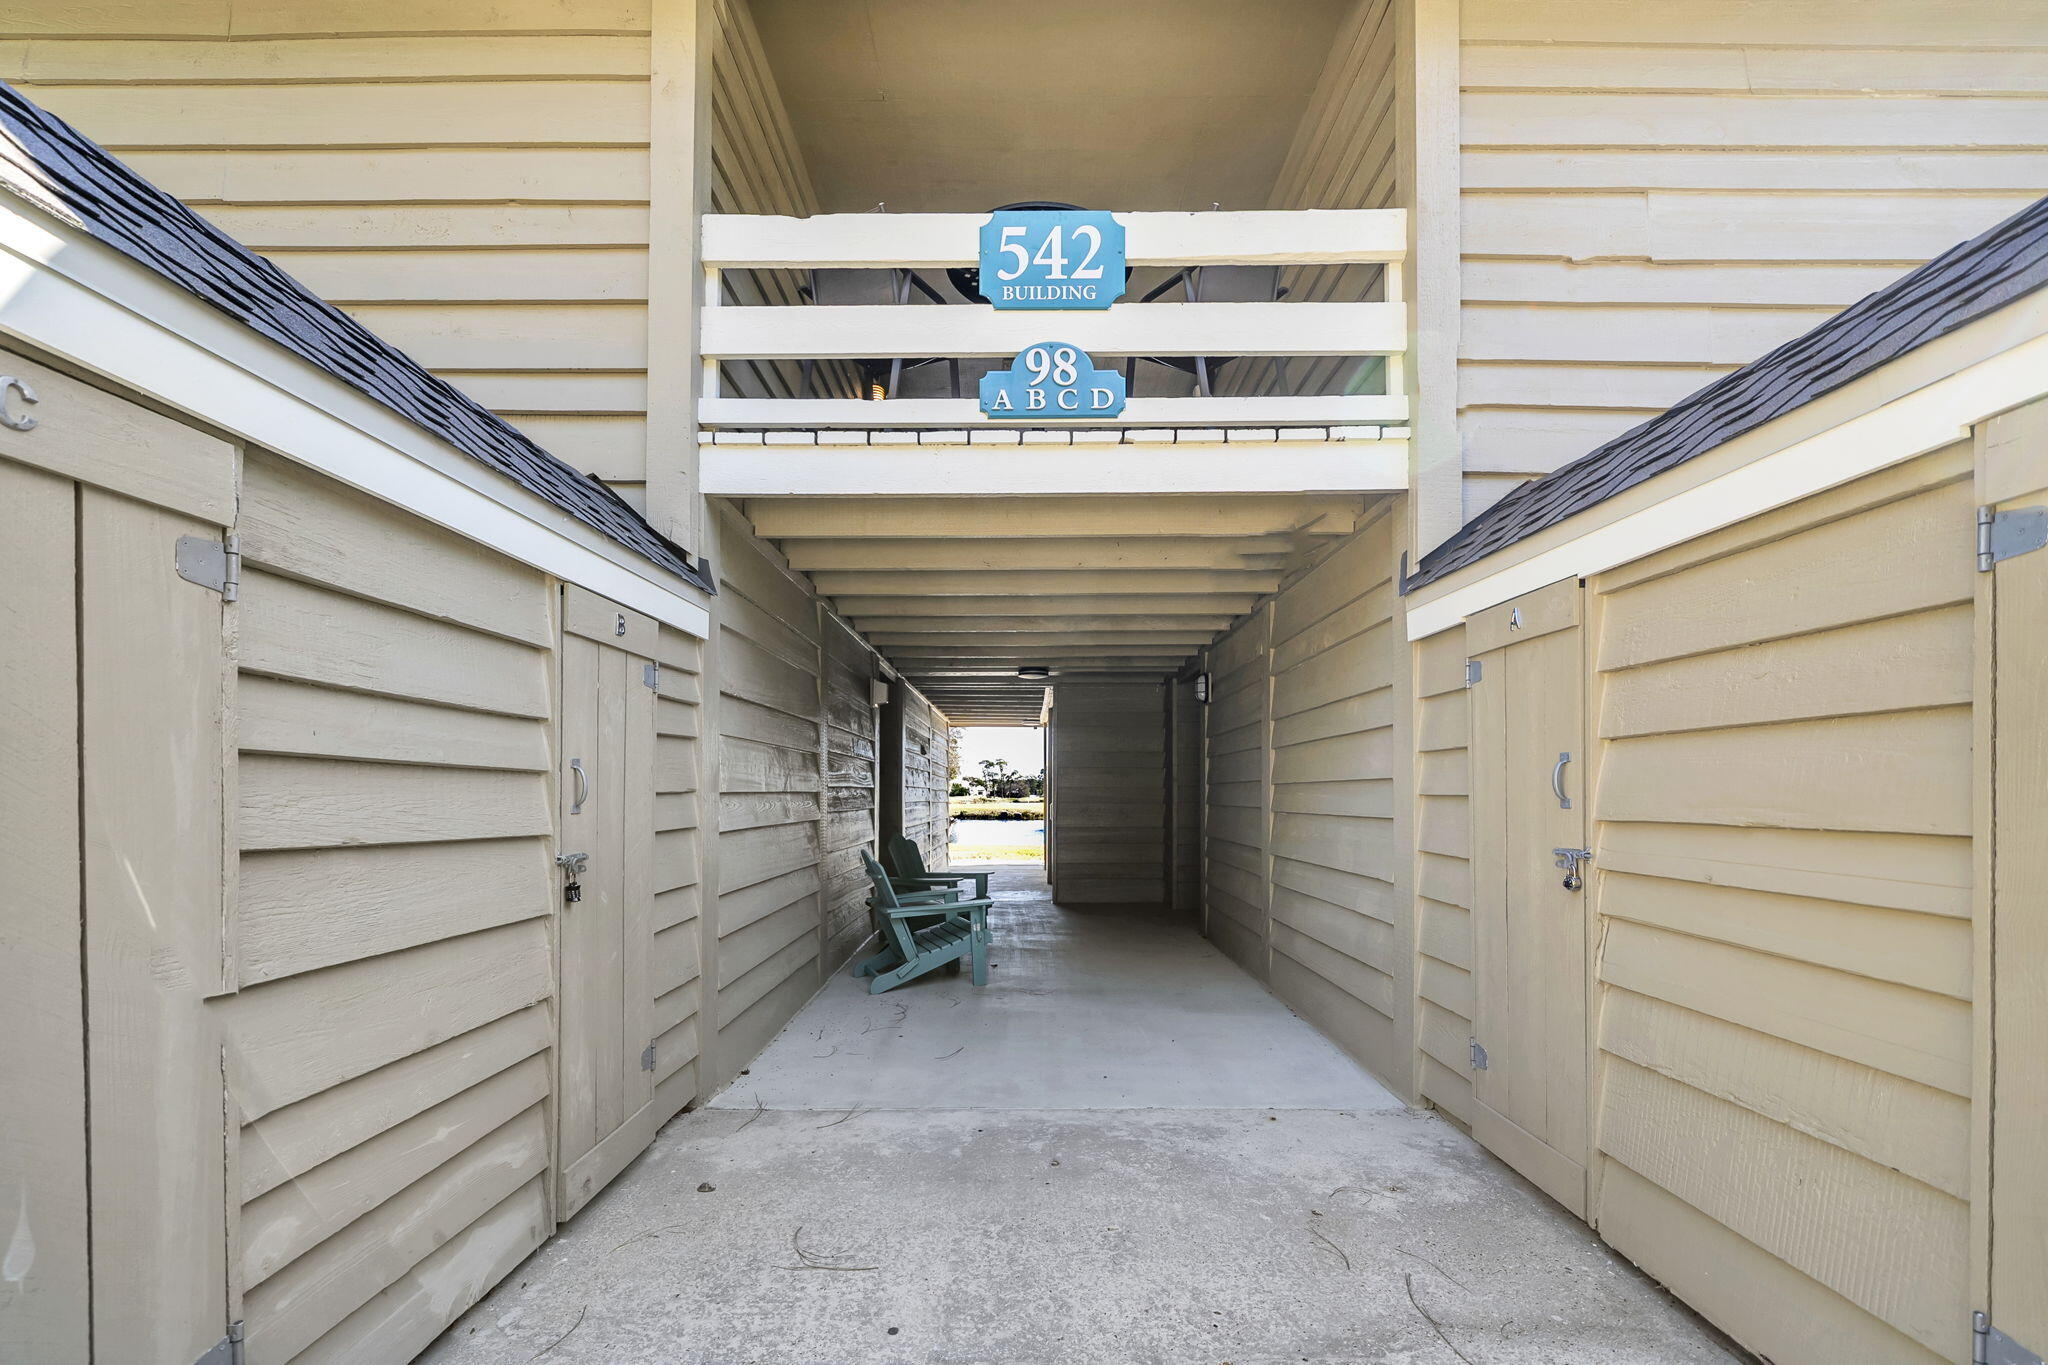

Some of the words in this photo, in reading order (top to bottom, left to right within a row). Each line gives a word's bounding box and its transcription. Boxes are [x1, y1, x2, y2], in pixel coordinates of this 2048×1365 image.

[997, 225, 1104, 280] 542
[1002, 286, 1096, 301] BUILDING
[1025, 347, 1078, 387] 98
[0, 374, 39, 432] C
[992, 389, 1014, 410] A
[1026, 389, 1046, 410] B
[1057, 389, 1078, 410] C
[1090, 389, 1115, 410] D
[615, 611, 626, 637] B
